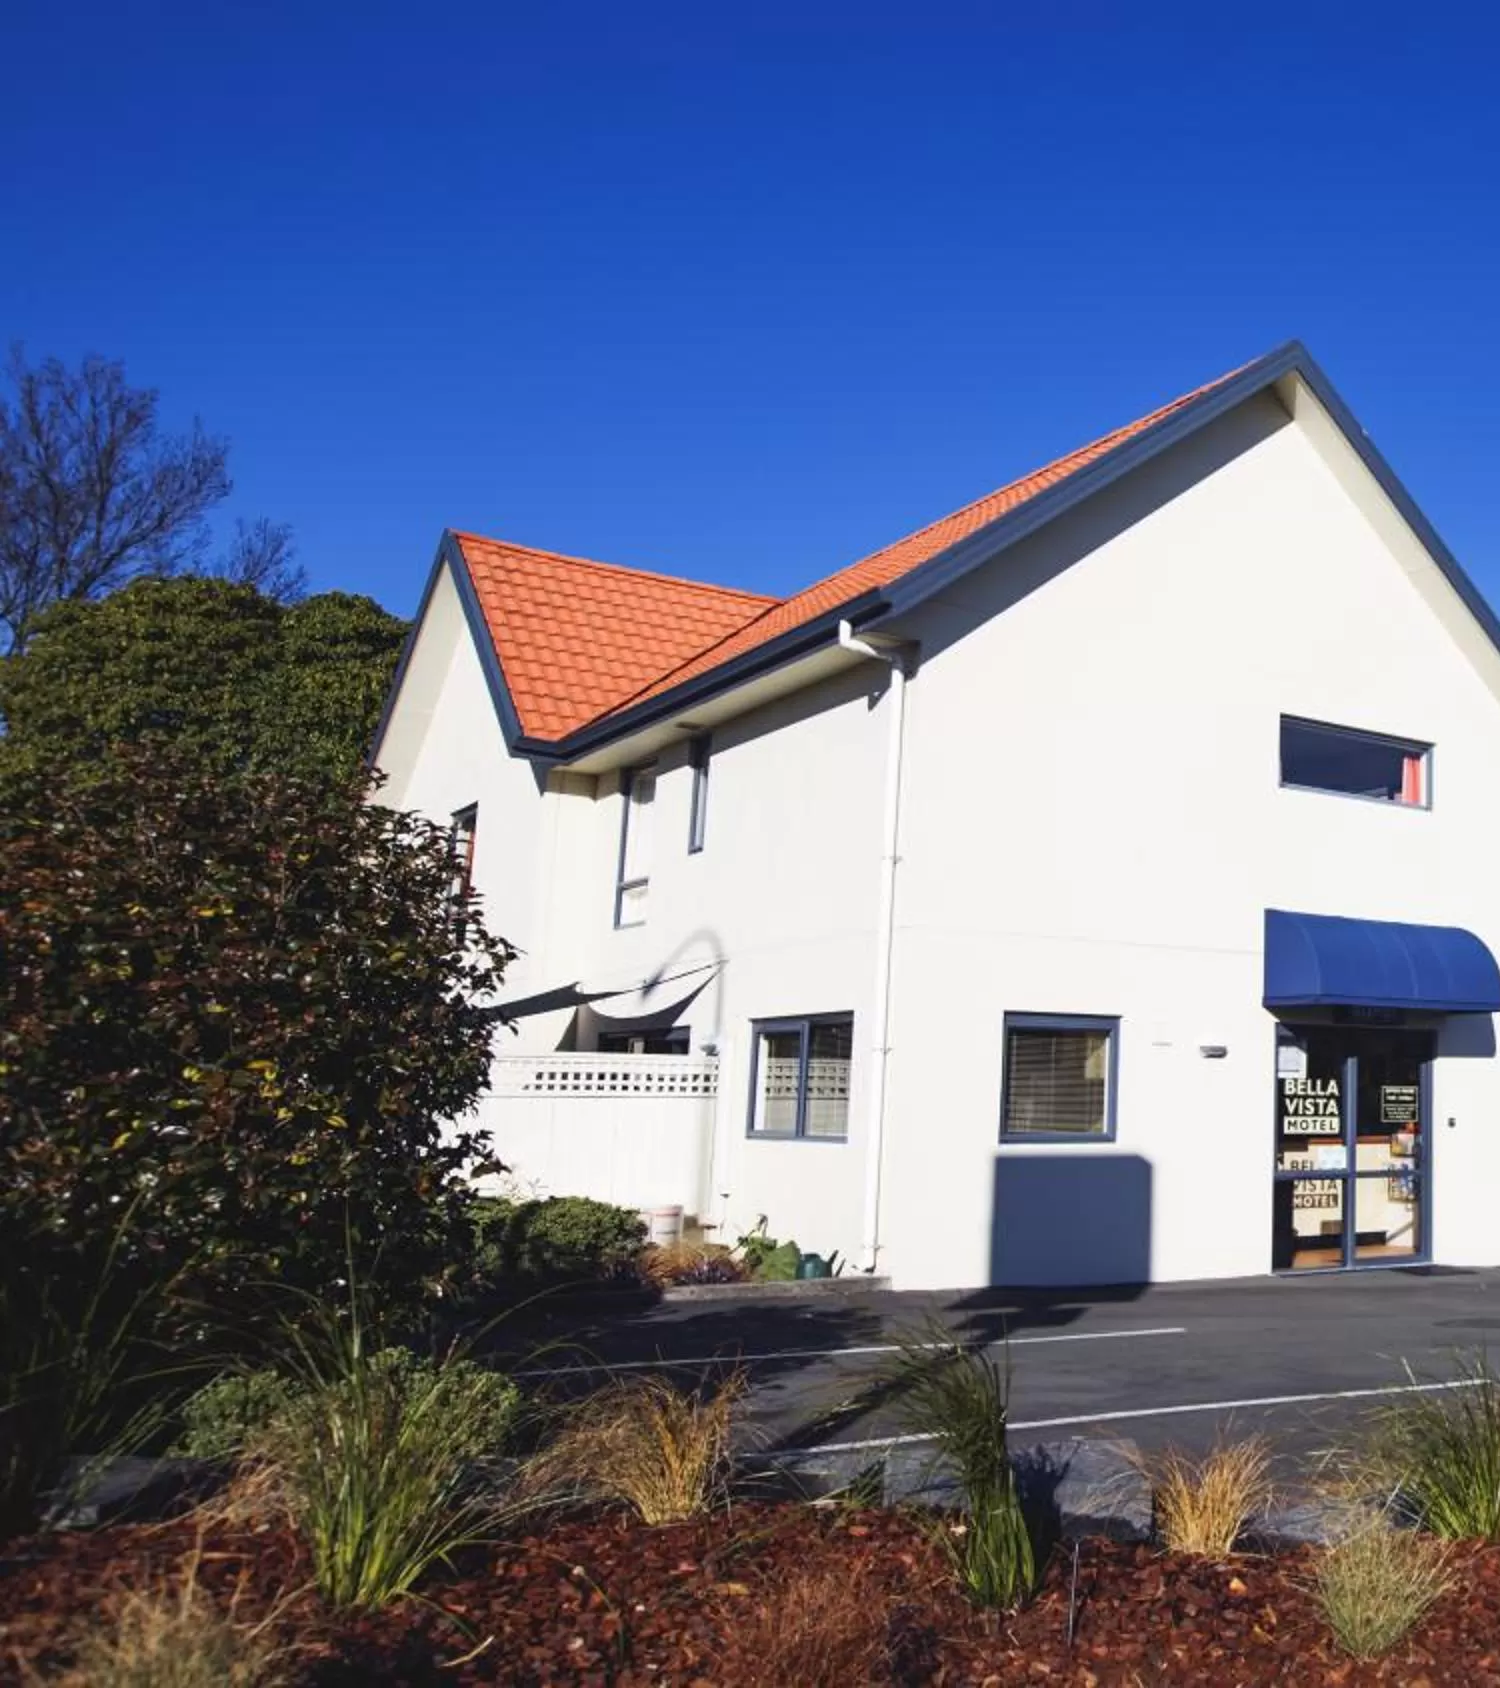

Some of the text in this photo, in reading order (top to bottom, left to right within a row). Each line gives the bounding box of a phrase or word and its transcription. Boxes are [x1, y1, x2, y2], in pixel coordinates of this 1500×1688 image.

[1284, 1079, 1339, 1096] BELLA
[1285, 1097, 1338, 1115] VISTA
[1287, 1119, 1336, 1131] MOTEL
